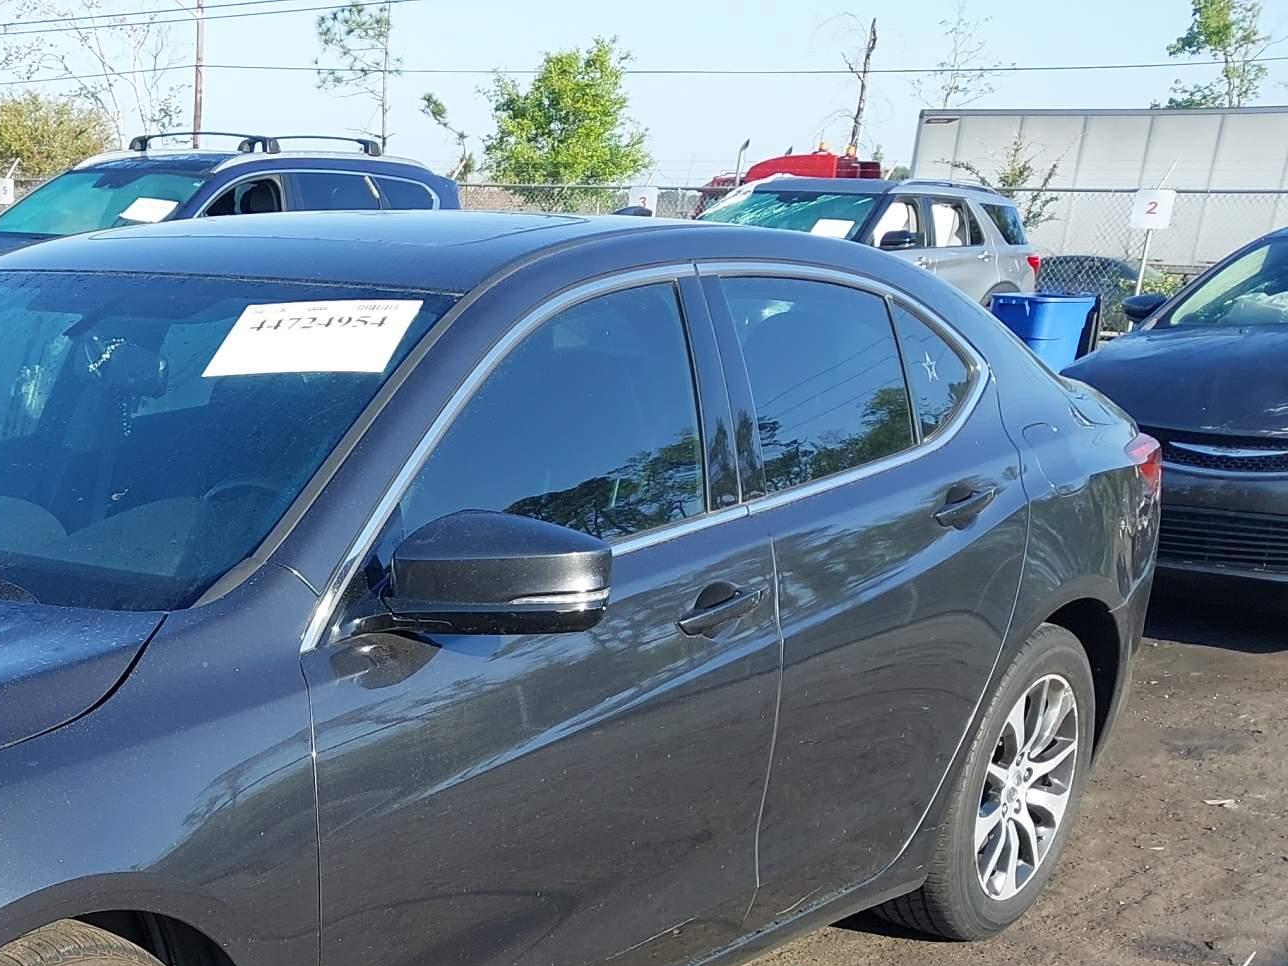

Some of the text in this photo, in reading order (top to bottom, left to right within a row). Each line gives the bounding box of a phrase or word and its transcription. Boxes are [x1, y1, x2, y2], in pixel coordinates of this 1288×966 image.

[2, 186, 8, 195] 5
[639, 196, 647, 208] 3
[1146, 201, 1159, 215] 2
[249, 315, 388, 331] 44724954
